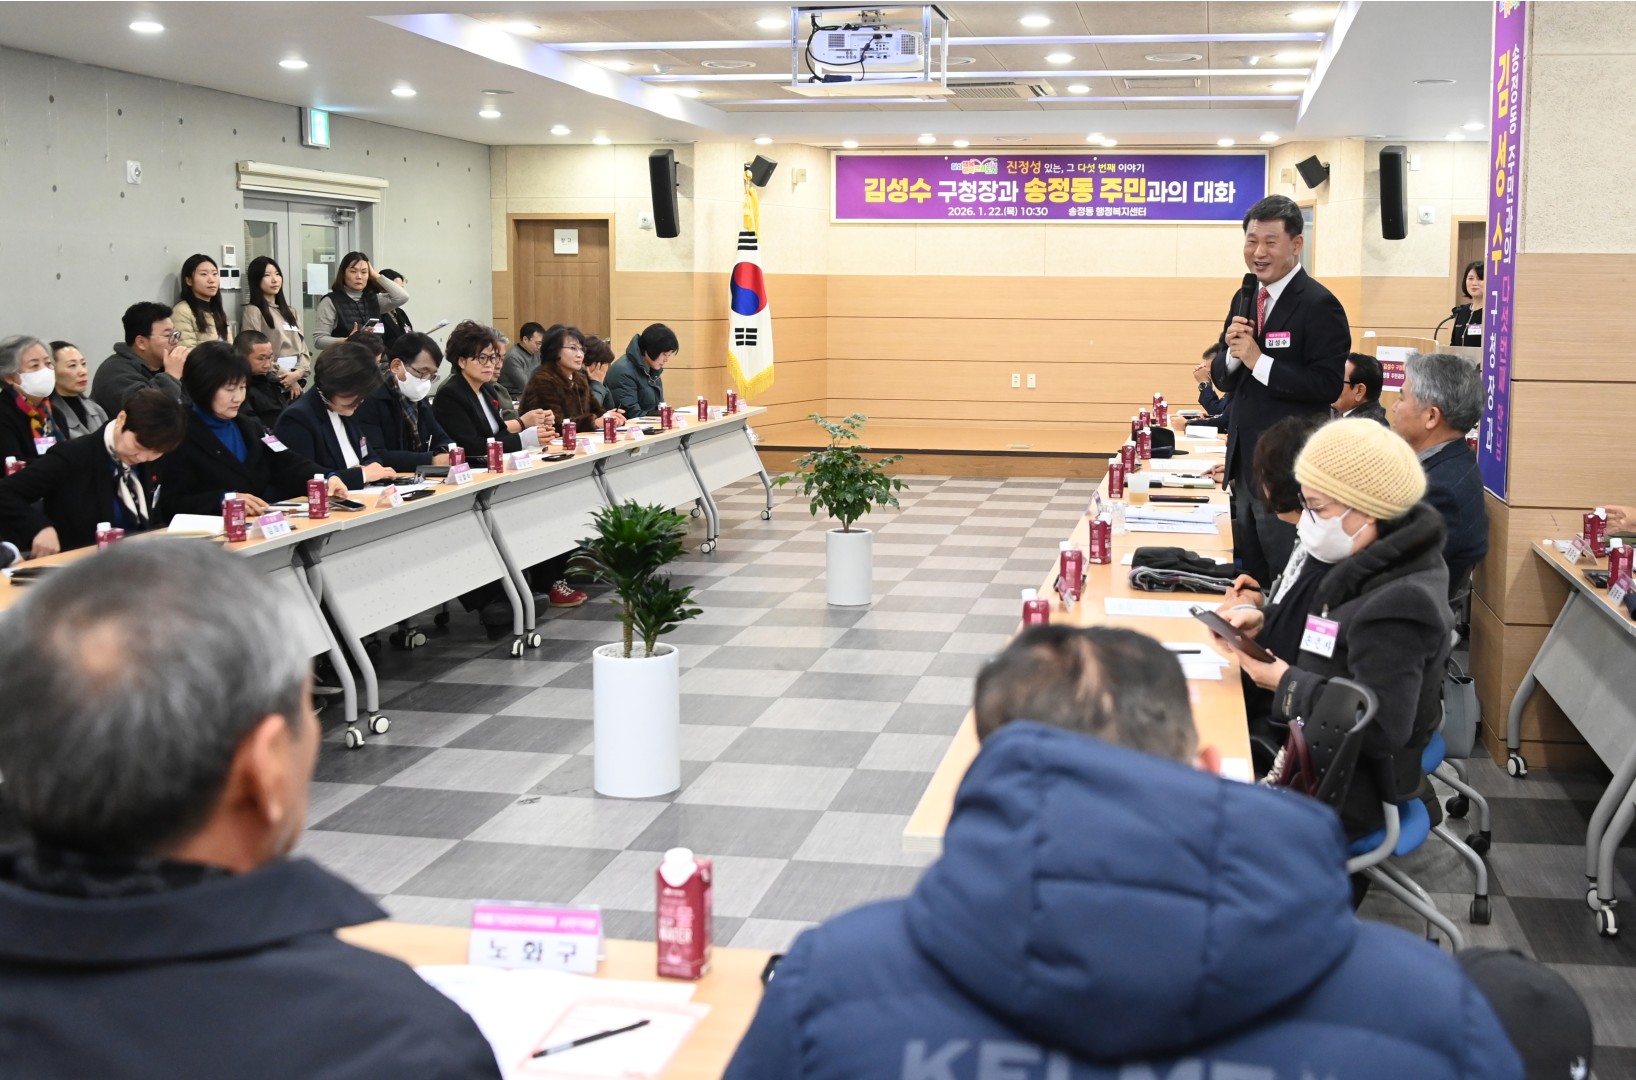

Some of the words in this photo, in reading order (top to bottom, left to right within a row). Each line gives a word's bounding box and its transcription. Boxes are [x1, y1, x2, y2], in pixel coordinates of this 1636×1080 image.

[1508, 43, 1520, 135] 송정동
[1007, 160, 1042, 174] 진정성
[1044, 163, 1064, 174] 있는,
[1066, 164, 1075, 172] 그
[1077, 163, 1096, 173] 다섯
[1098, 163, 1116, 173] 번째
[1118, 163, 1145, 173] 이야기
[1491, 49, 1511, 276] 김성수
[864, 177, 931, 203] 김성수
[937, 180, 1018, 203] 구청장과
[1024, 177, 1094, 203] 송정동
[1100, 177, 1187, 203] 주민과의
[1193, 180, 1236, 203] 대화
[948, 207, 975, 216] 2026.
[1020, 207, 1048, 216] 10:30
[1068, 207, 1094, 216] 송정동
[1095, 207, 1147, 216] 행정복지센터
[1503, 144, 1516, 265] 주민과의
[1268, 339, 1287, 347] 김성수
[1485, 290, 1498, 454] 구청장과
